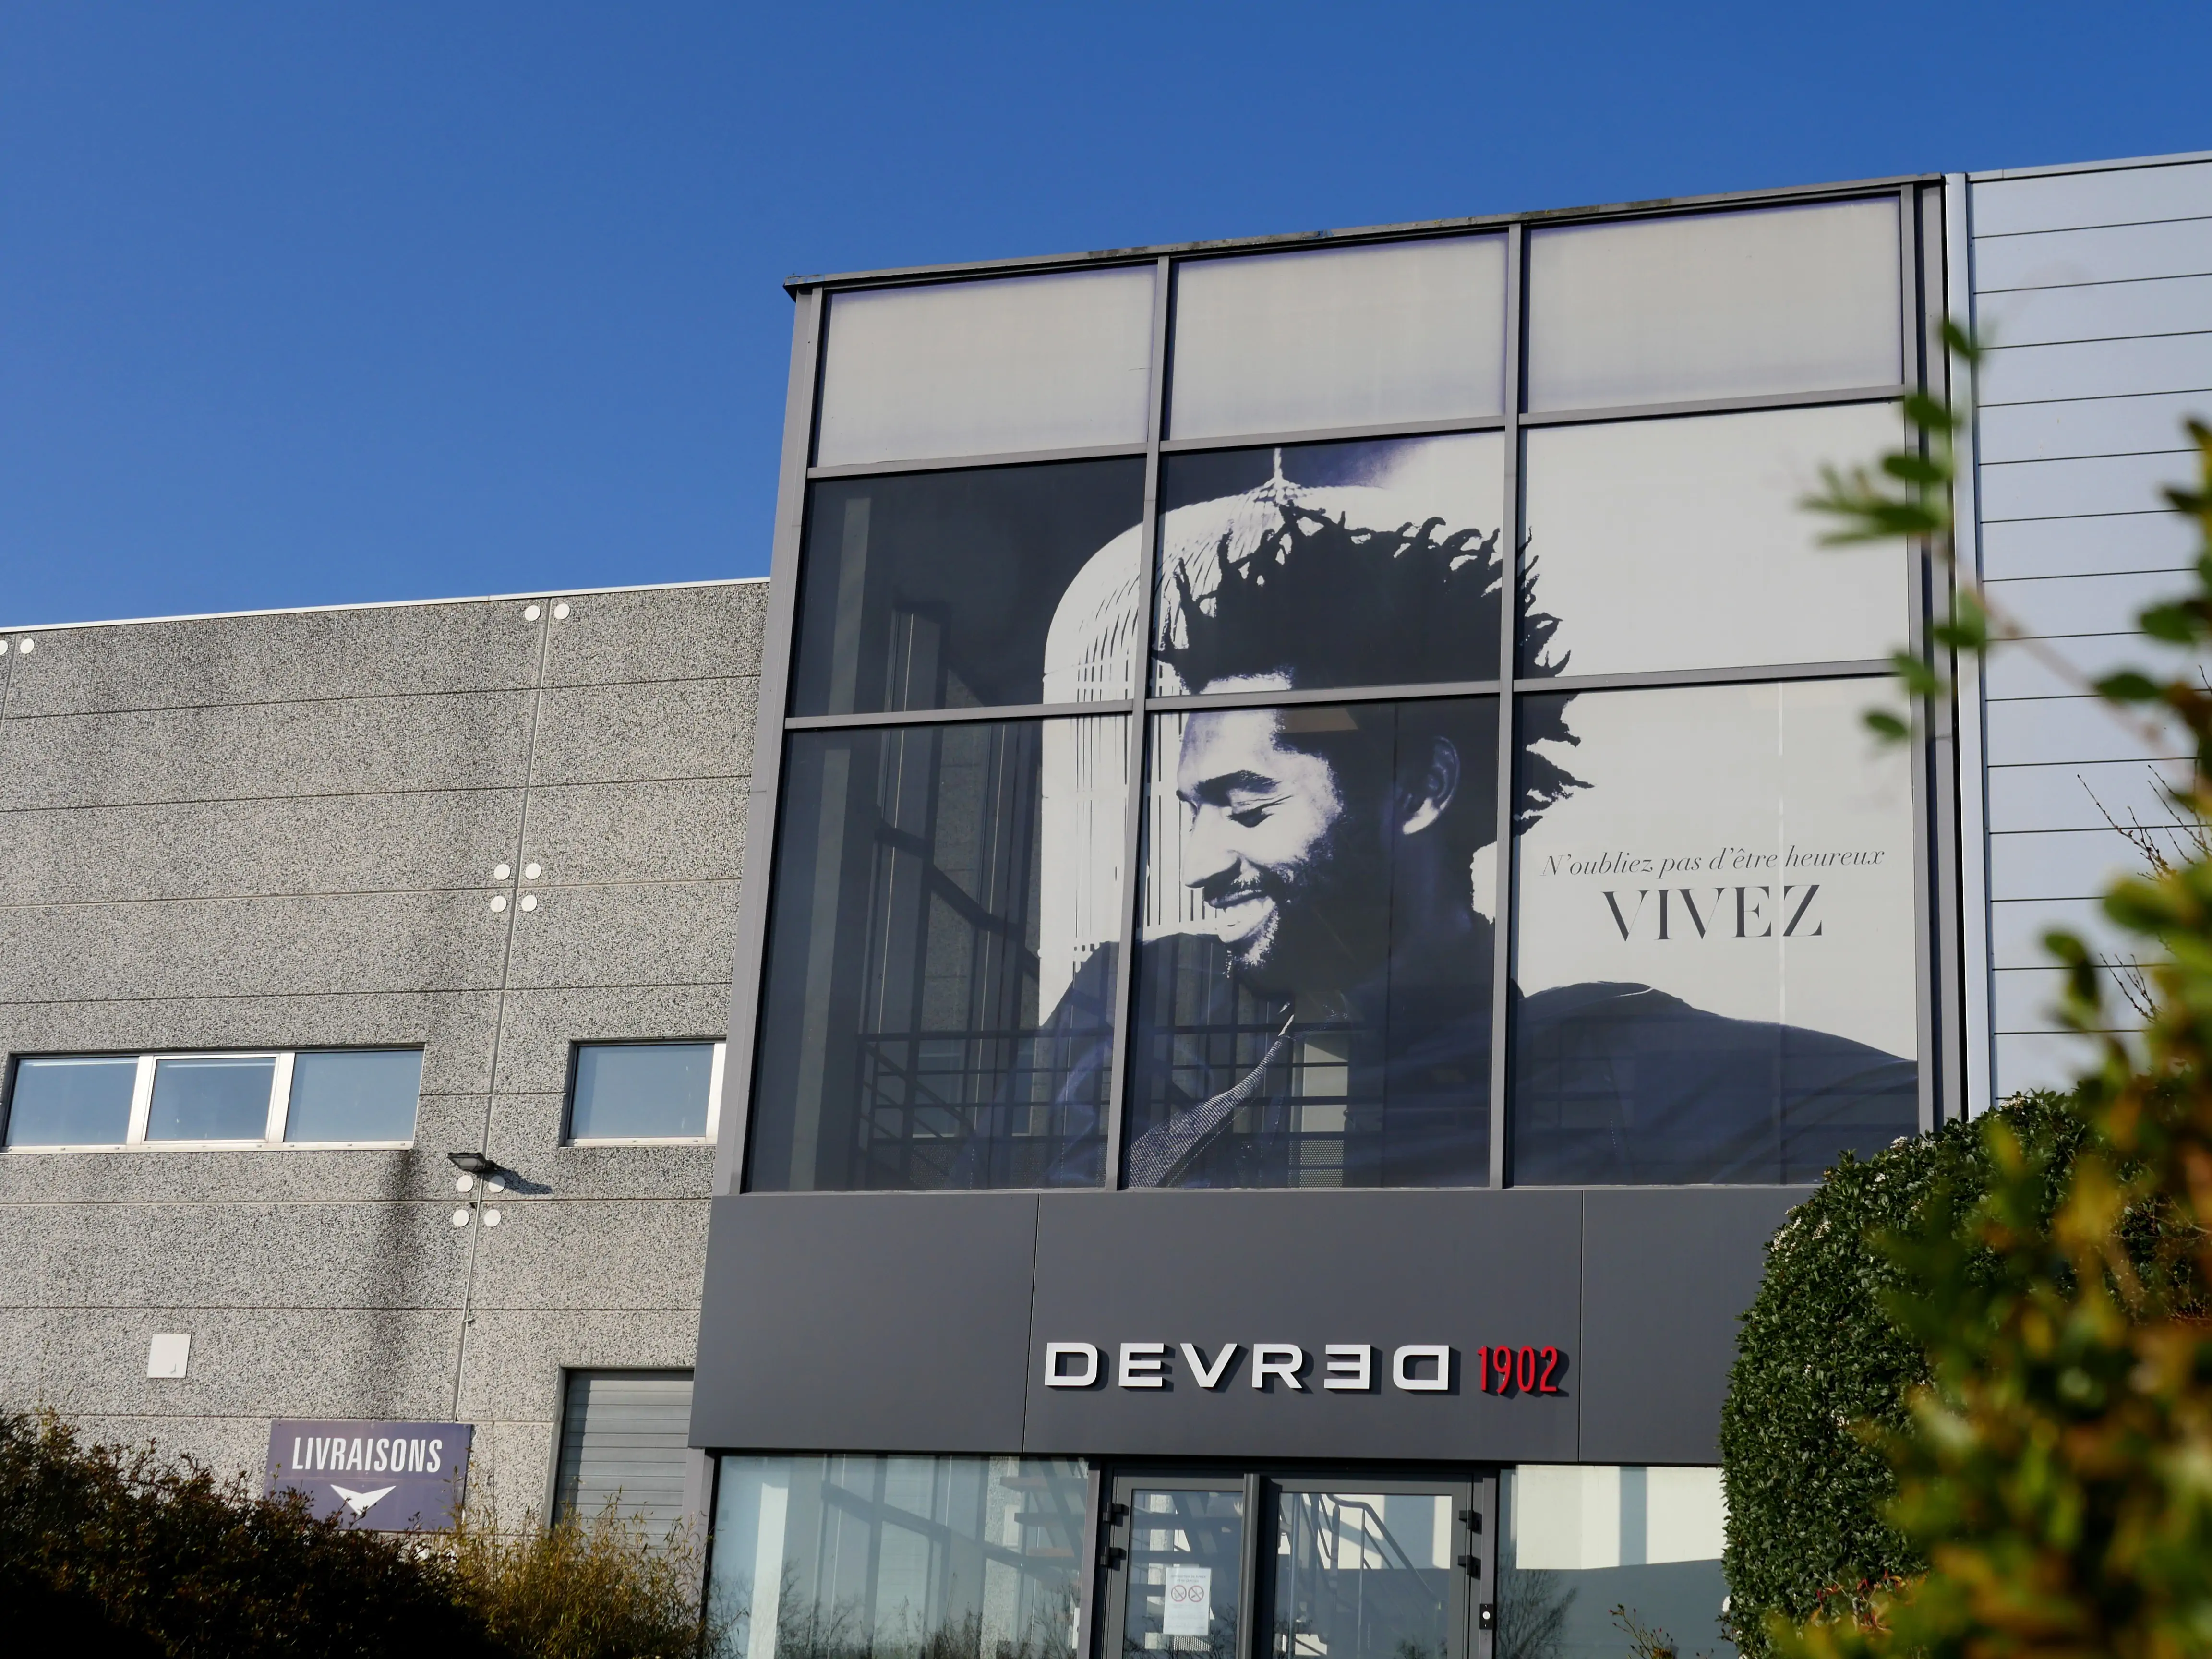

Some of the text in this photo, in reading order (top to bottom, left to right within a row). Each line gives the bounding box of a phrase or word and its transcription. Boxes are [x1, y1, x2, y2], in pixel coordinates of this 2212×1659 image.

[1540, 845, 1886, 879] N'oubliez pas d'être heureux
[1600, 884, 1823, 942] VIVEZ
[1477, 1345, 1559, 1393] 1902
[291, 1437, 443, 1473] LIVRAISONS
